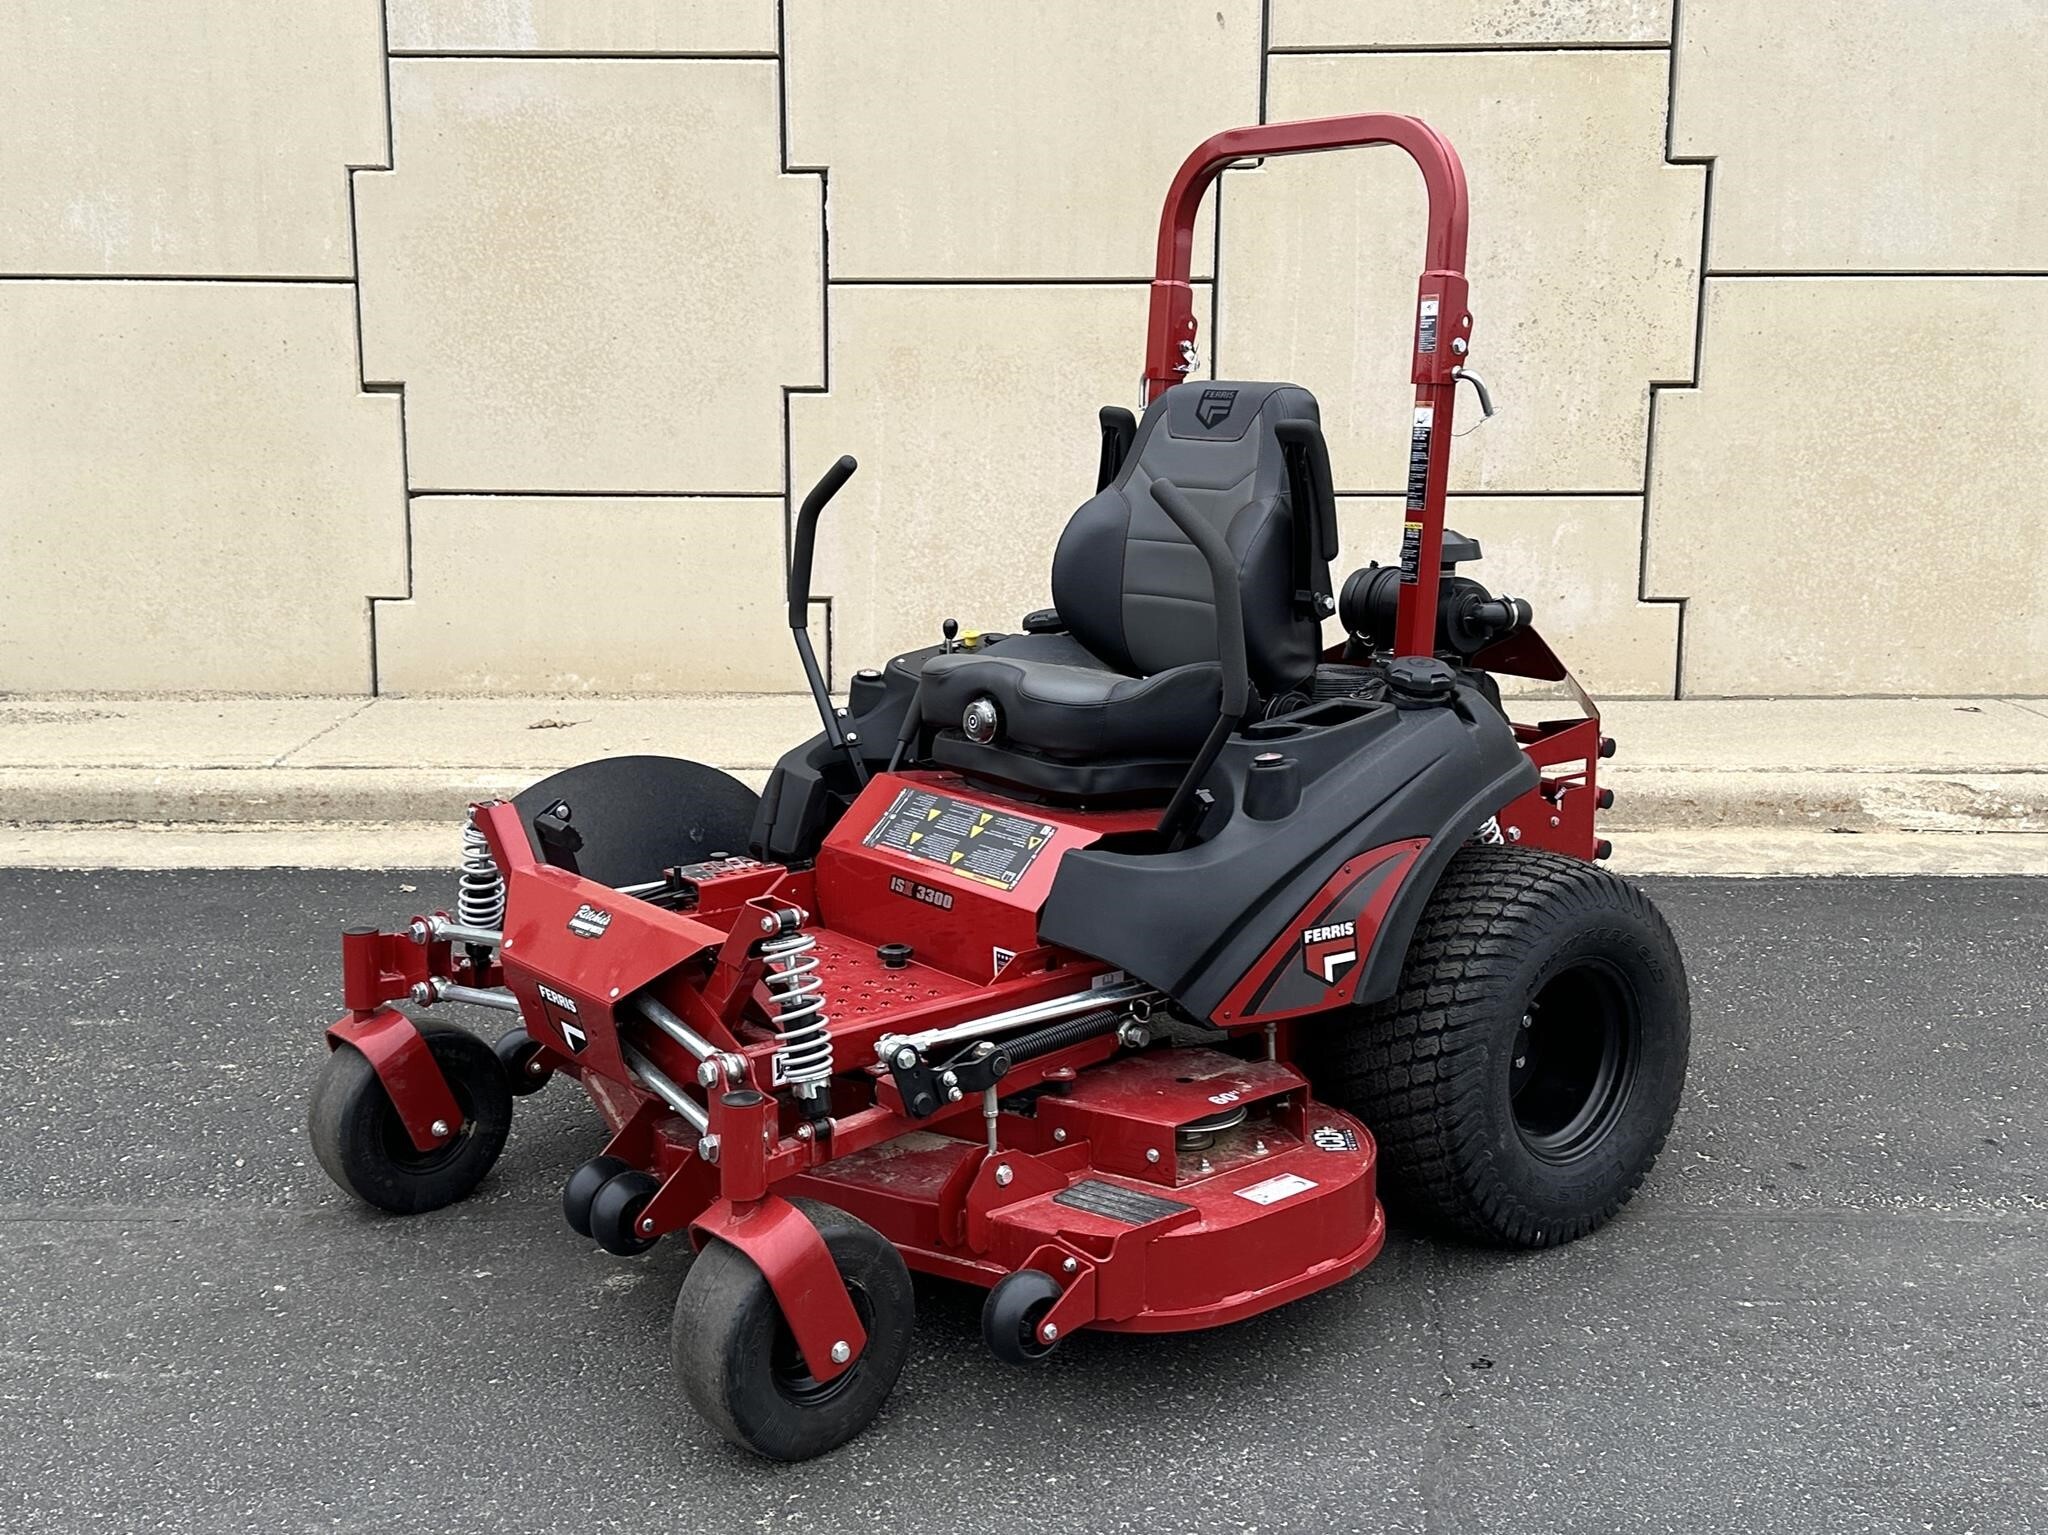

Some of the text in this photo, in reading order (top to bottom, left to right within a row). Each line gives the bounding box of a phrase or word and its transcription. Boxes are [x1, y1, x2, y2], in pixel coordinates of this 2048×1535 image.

[1204, 390, 1235, 399] FERRIS
[916, 885, 953, 909] 3300
[1303, 921, 1355, 944] FERRIS
[537, 983, 577, 1014] FERRIS
